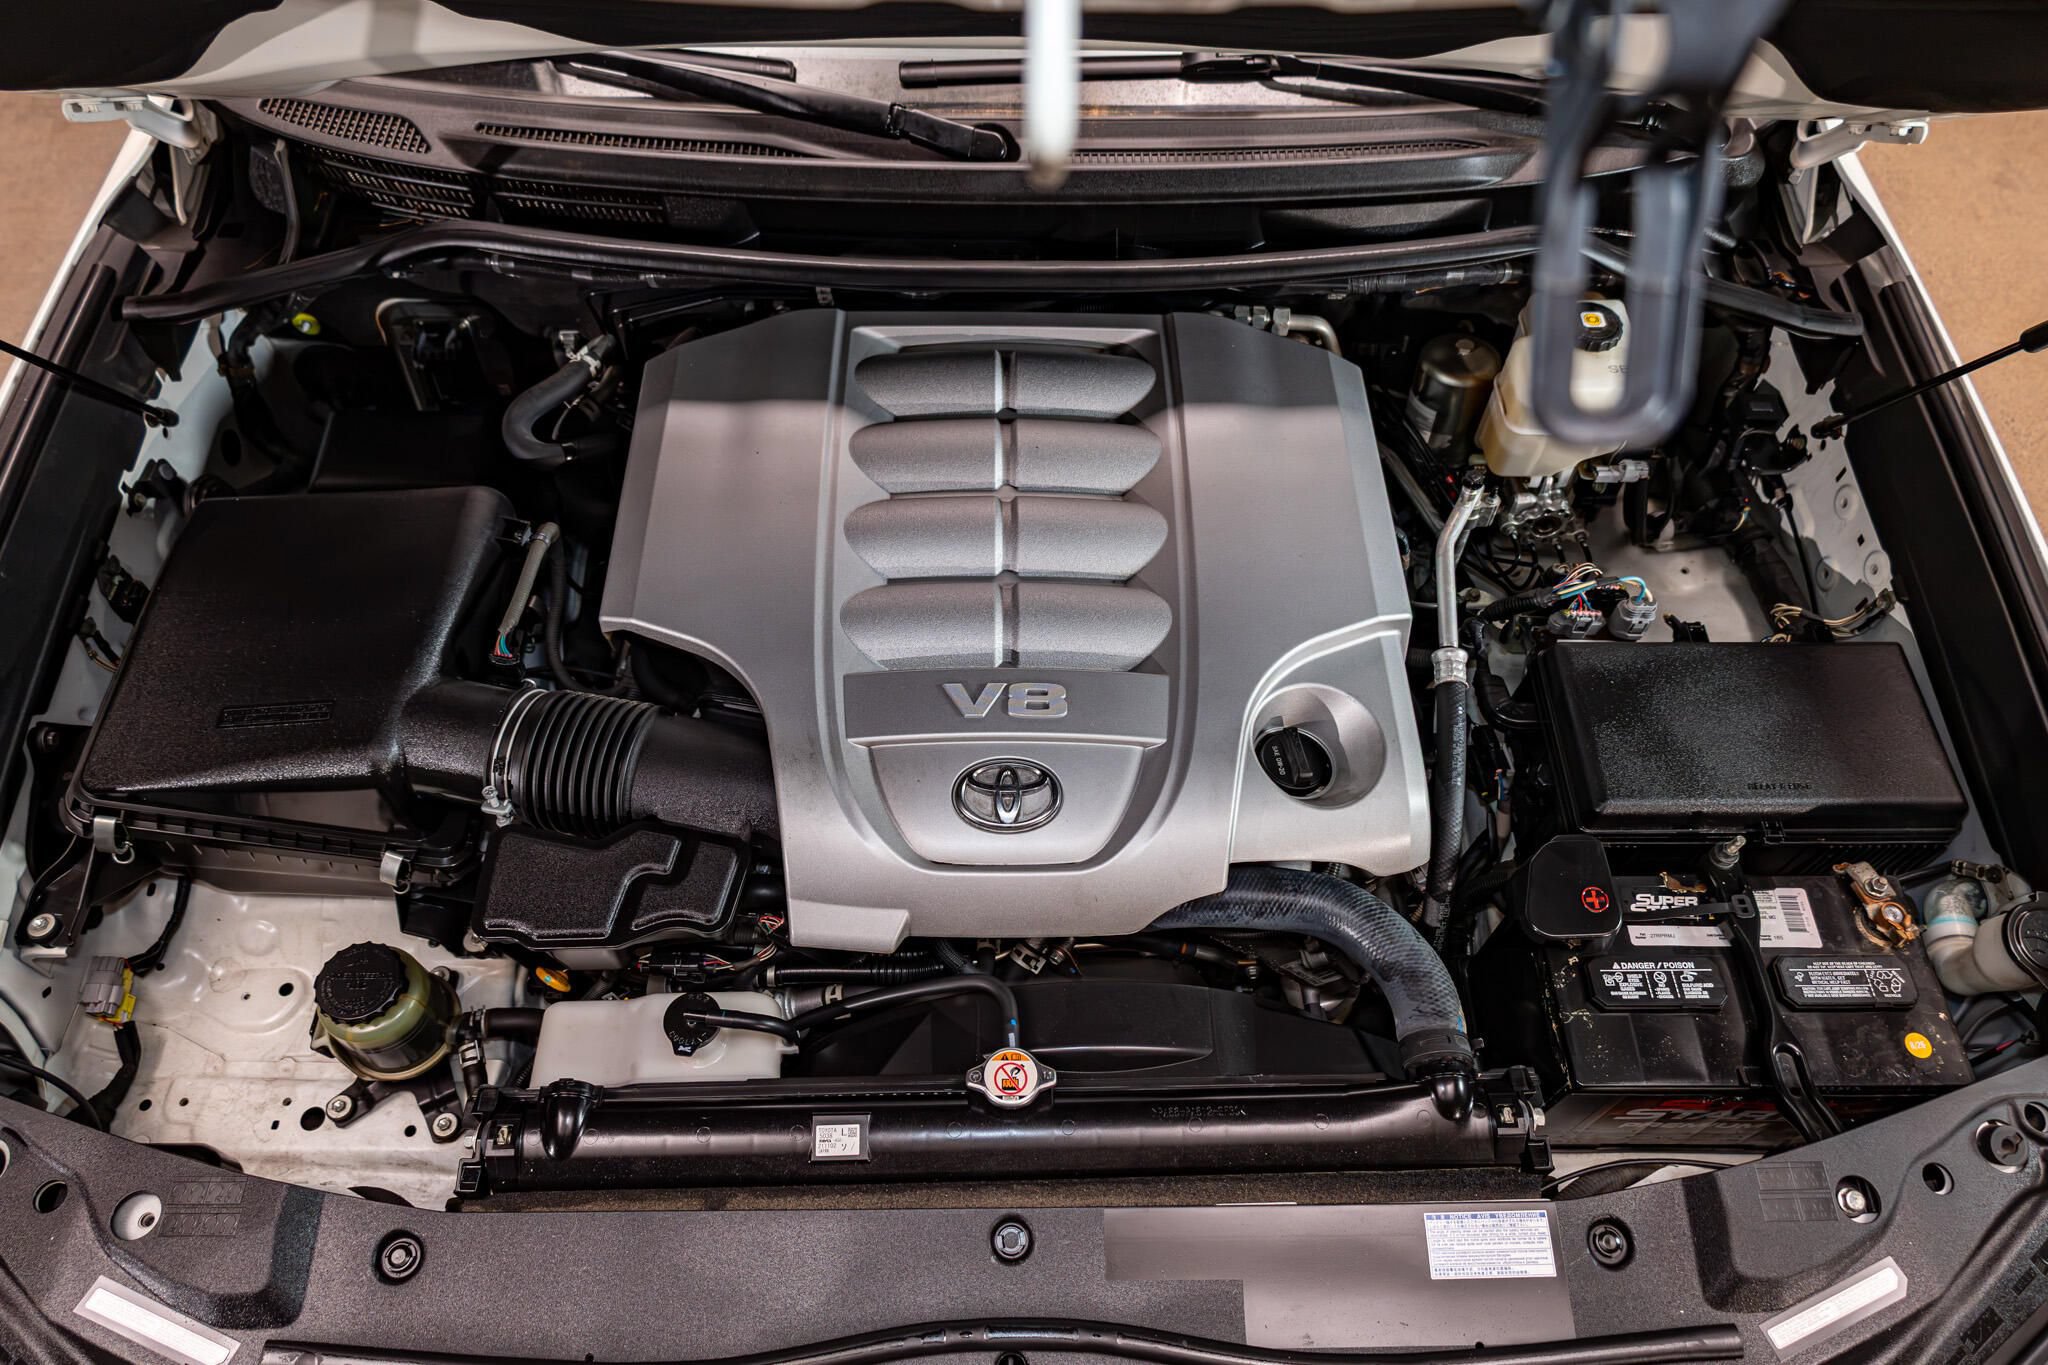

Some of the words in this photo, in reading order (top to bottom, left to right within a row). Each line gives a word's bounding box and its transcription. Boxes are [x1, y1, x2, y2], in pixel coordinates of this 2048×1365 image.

[942, 682, 1068, 719] V8
[1635, 893, 1699, 907] SUPER
[1620, 961, 1656, 969] DANGER
[1663, 961, 1695, 969] POISON
